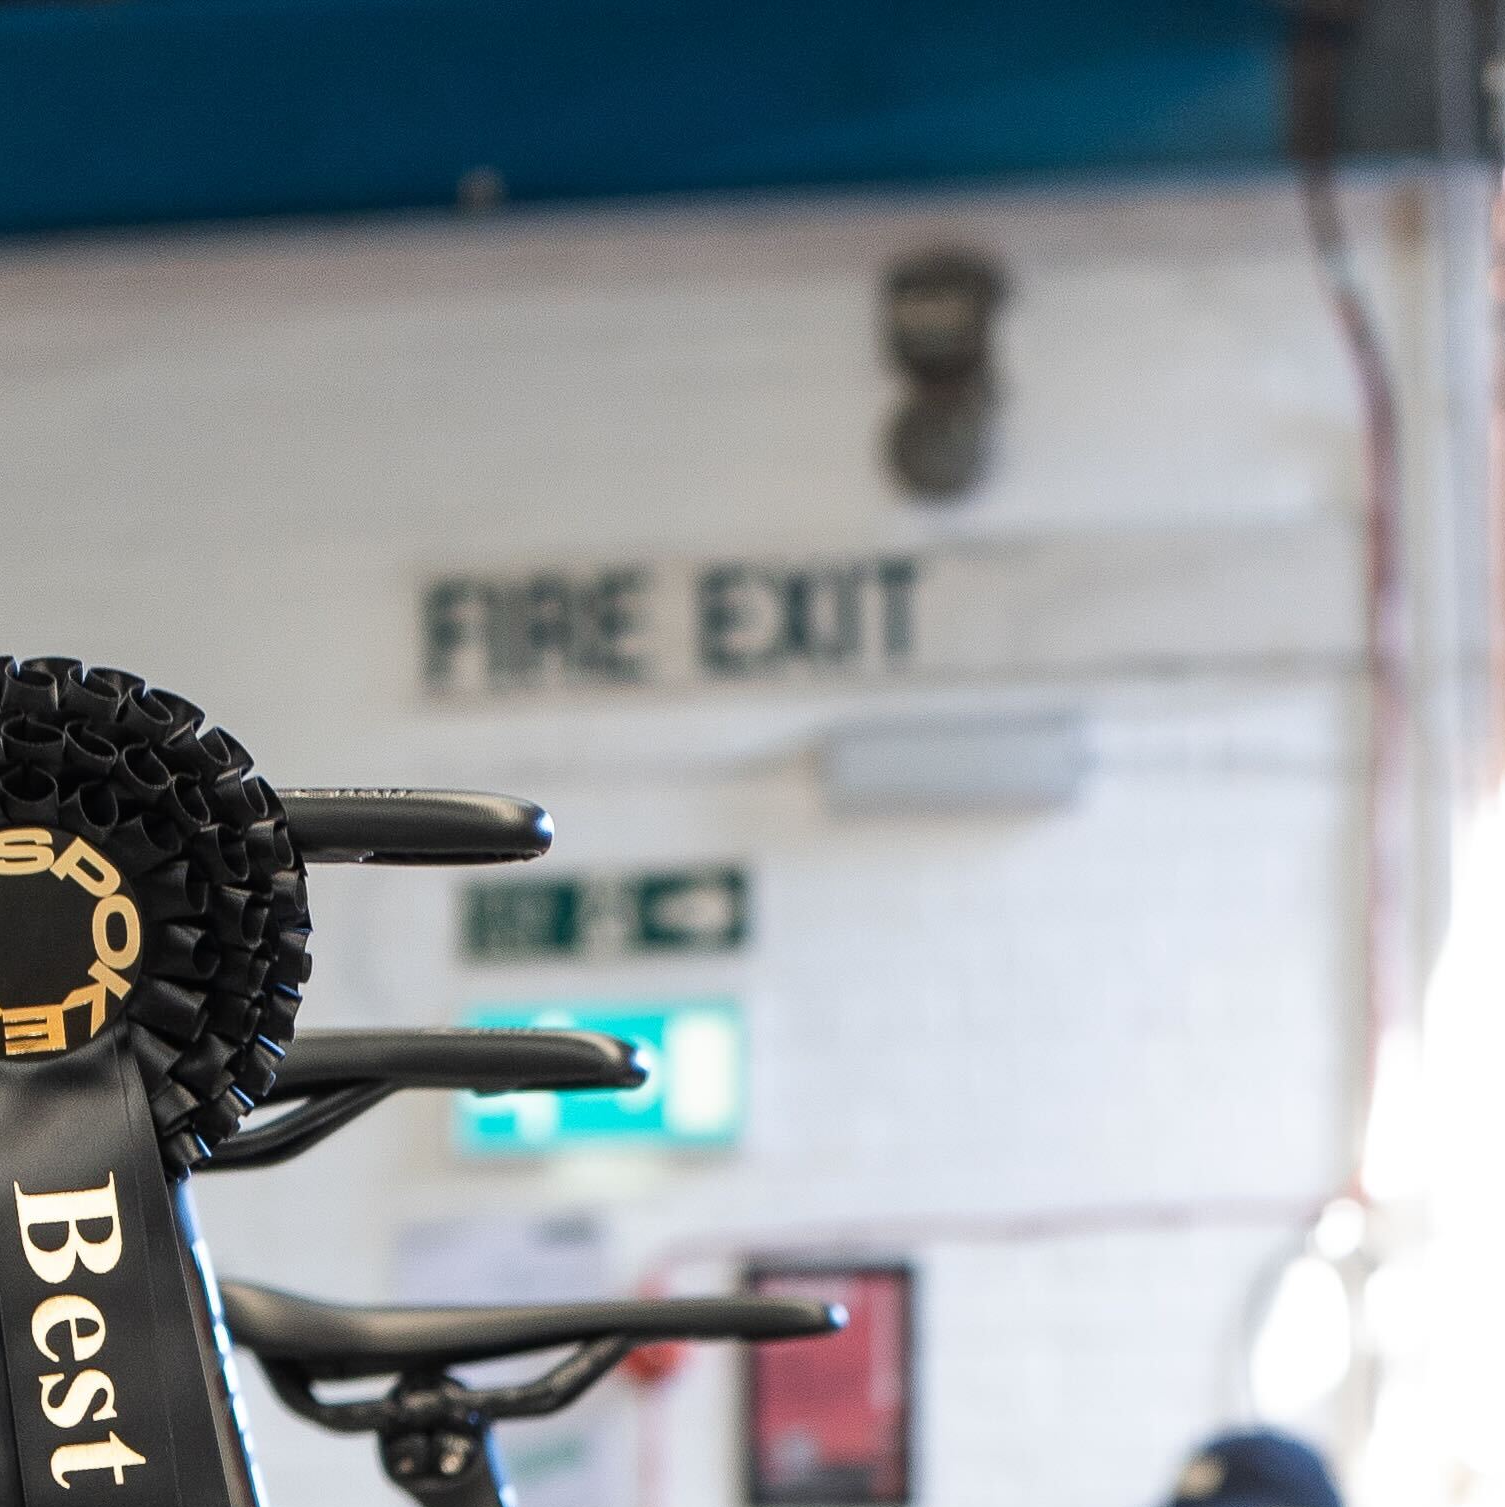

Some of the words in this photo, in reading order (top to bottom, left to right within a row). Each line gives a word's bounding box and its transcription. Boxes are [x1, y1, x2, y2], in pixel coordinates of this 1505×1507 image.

[419, 565, 650, 693] FIRE
[696, 554, 921, 676] EXIT
[12, 1168, 149, 1490] Best
